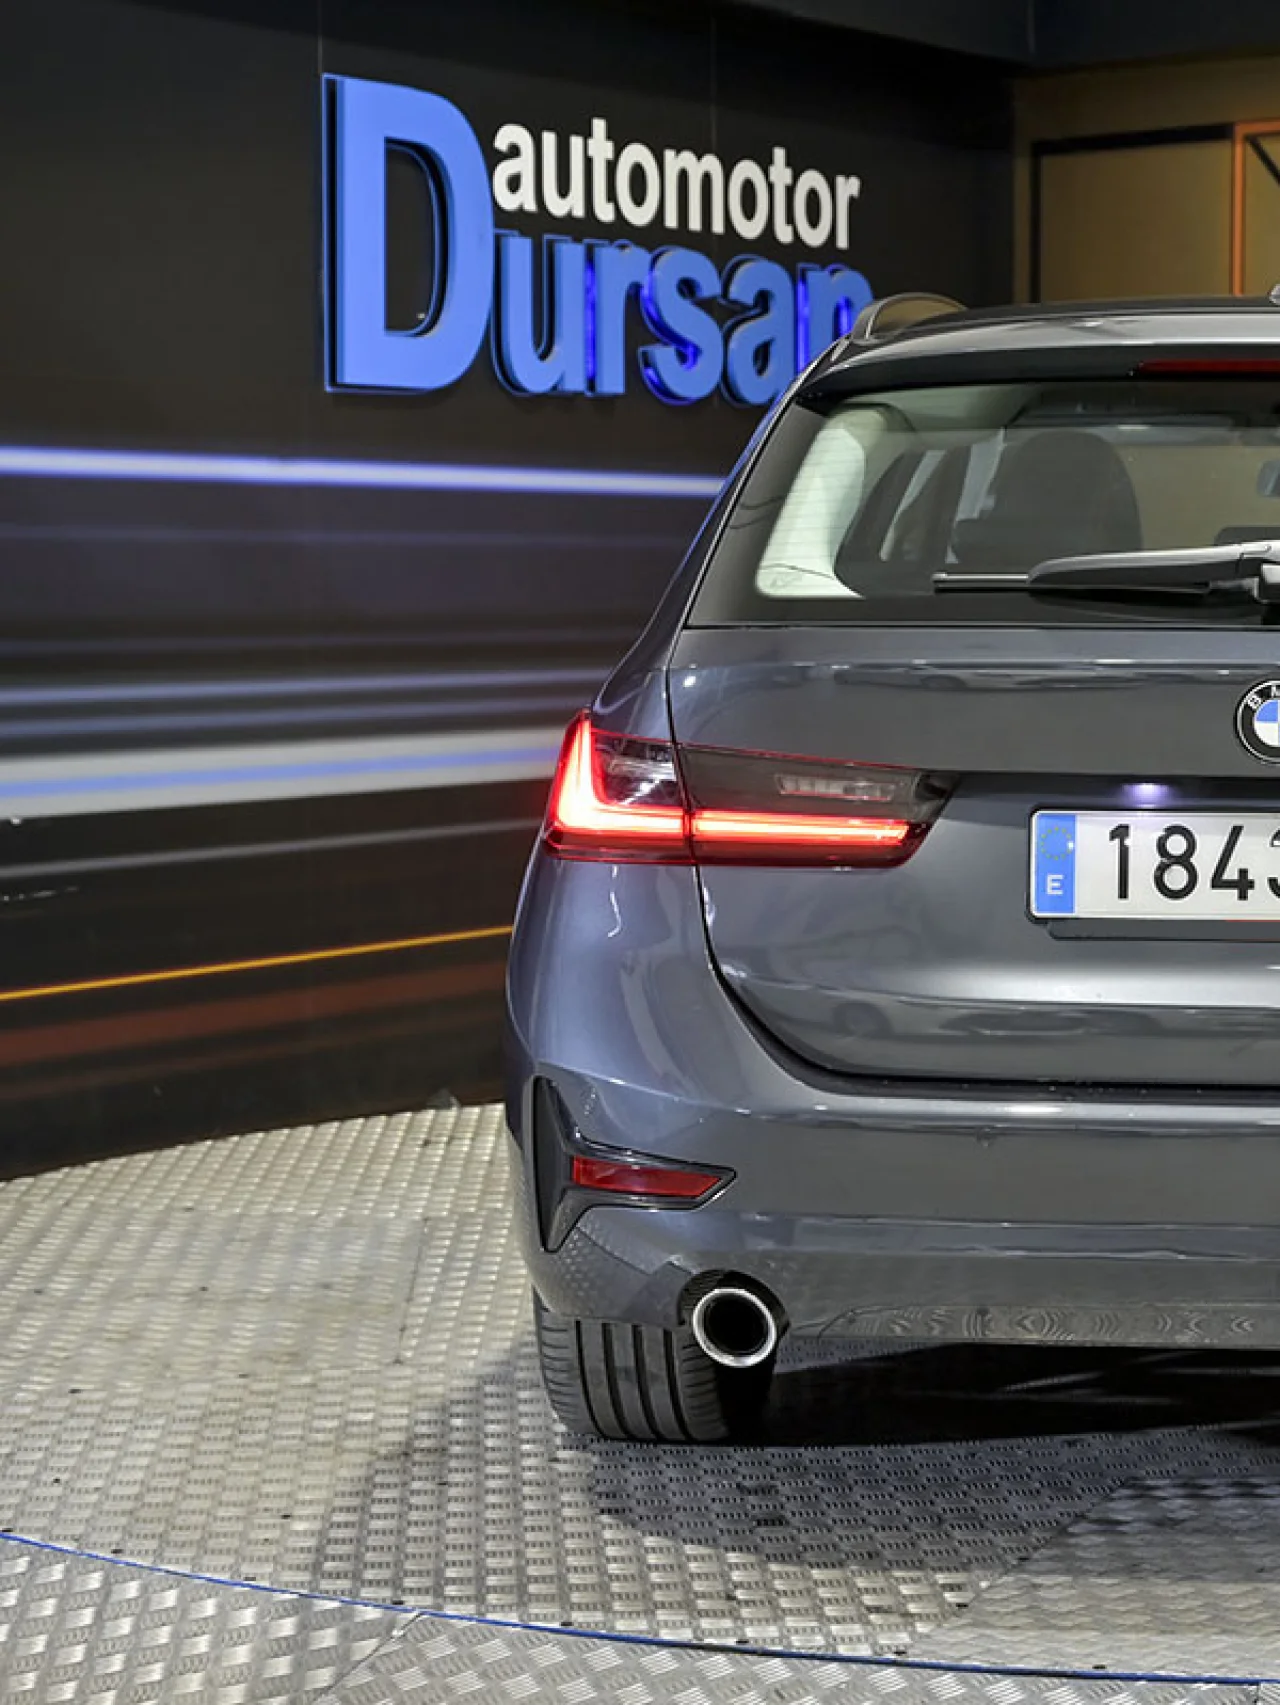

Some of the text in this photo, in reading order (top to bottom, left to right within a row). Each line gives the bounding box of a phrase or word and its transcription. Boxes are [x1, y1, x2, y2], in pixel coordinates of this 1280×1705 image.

[322, 72, 874, 408] Dursan
[492, 117, 861, 250] automotor
[1046, 873, 1065, 895] E
